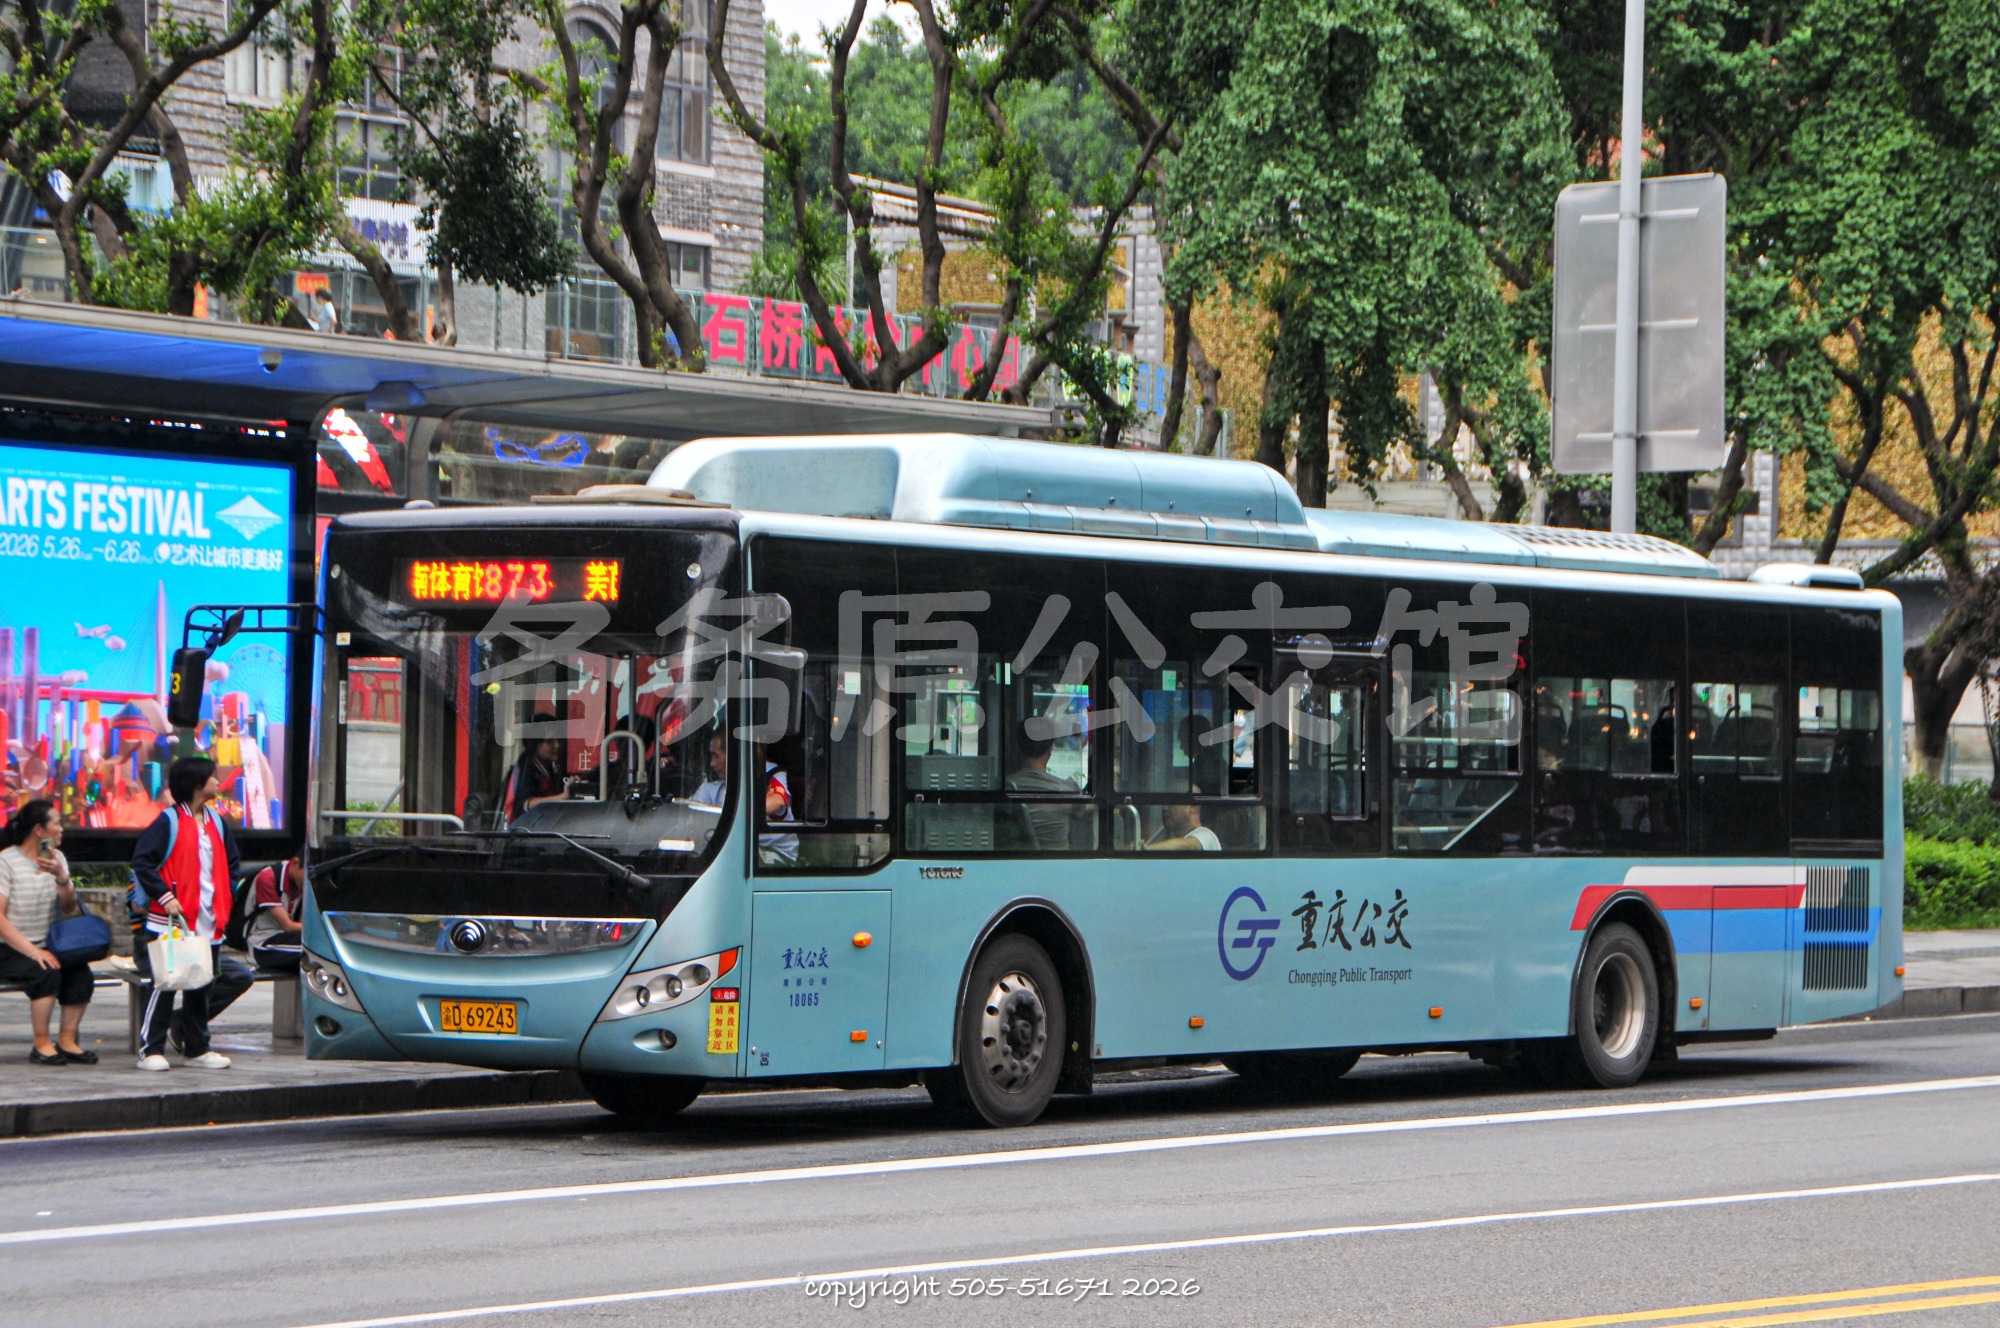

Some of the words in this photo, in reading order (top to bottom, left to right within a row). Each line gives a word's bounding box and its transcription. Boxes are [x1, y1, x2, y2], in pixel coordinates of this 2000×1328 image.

[74, 482, 211, 539] FESTIVAL
[0, 532, 39, 558] 2026
[42, 534, 81, 560] 5.26
[485, 562, 547, 599] 873
[1291, 889, 1412, 951] 重庆公交
[782, 947, 829, 969] 重庆公交
[1288, 969, 1337, 987] Chongqing
[1339, 968, 1367, 982] Public
[1369, 967, 1412, 984] Transport
[789, 992, 820, 1007] 18065
